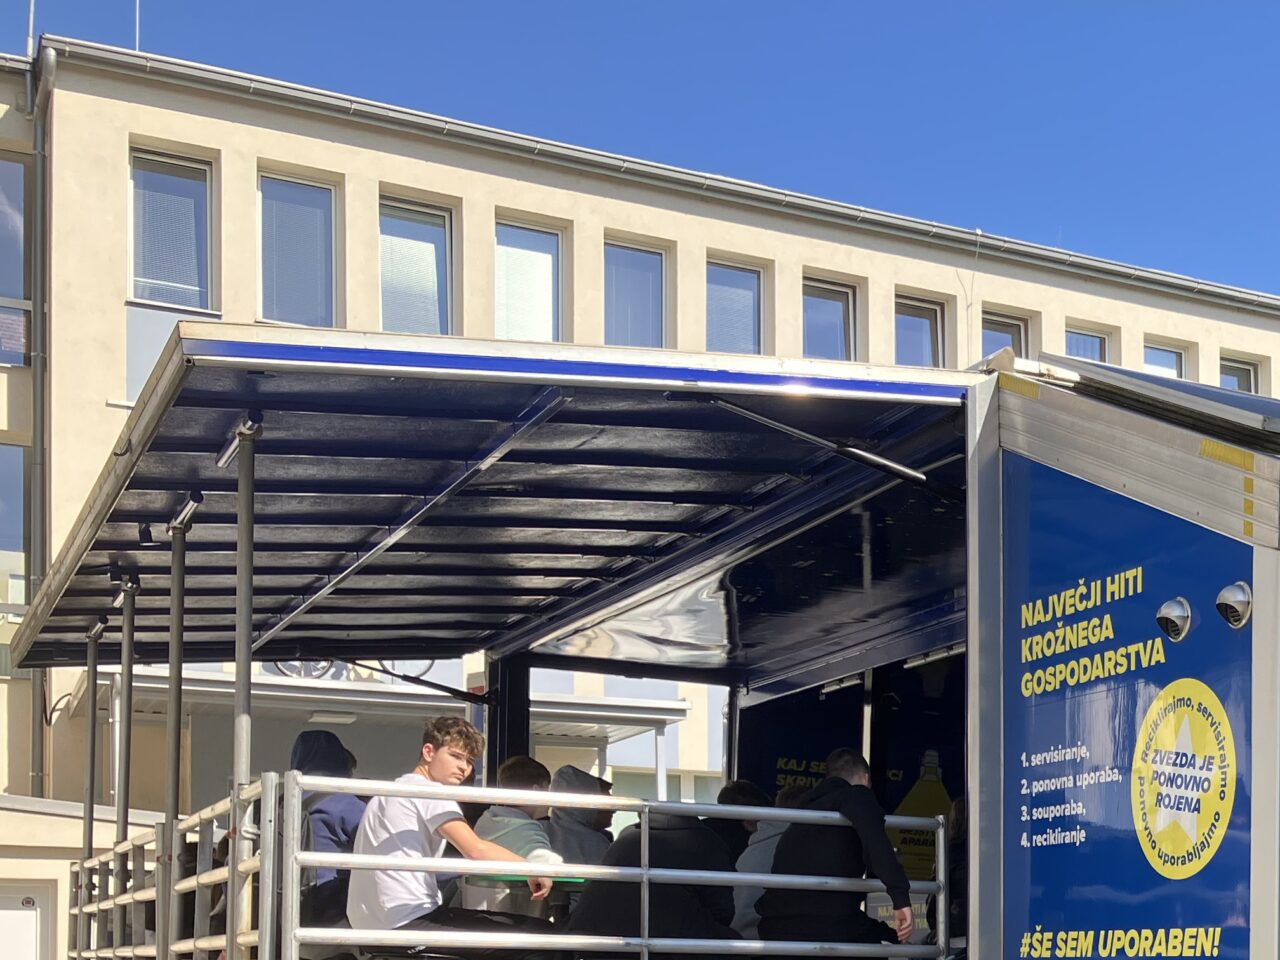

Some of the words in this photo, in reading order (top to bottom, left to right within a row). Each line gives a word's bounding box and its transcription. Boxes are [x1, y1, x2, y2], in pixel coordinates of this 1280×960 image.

[1020, 577, 1102, 629] NAJVEČJI
[1106, 566, 1143, 603] HITI
[1020, 613, 1115, 663] KROŽNEGA
[1020, 637, 1166, 698] GOSPODARSTVA
[776, 757, 806, 772] KAJ
[1020, 752, 1030, 768] 1.
[1031, 743, 1090, 768] servisiranje,
[1151, 748, 1197, 770] ZVEZDA
[1199, 754, 1216, 772] JE
[1196, 702, 1230, 801] servisirajmo
[1020, 779, 1031, 795] 2.
[1032, 775, 1074, 797] ponovna
[1076, 766, 1123, 794] uporaba,
[1150, 770, 1212, 794] PONOVNO
[1020, 805, 1031, 822] 3.
[1032, 800, 1086, 823] souporaba,
[1155, 791, 1201, 814] ROJENA
[1138, 775, 1157, 850] ponovno
[1157, 811, 1221, 866] uporabljajmo
[1020, 832, 1031, 848] 4.
[1032, 826, 1086, 848] recikliranje
[1019, 924, 1053, 959] #ŠE
[1055, 930, 1094, 959] SEM
[1098, 926, 1222, 959] UPORABEN!
